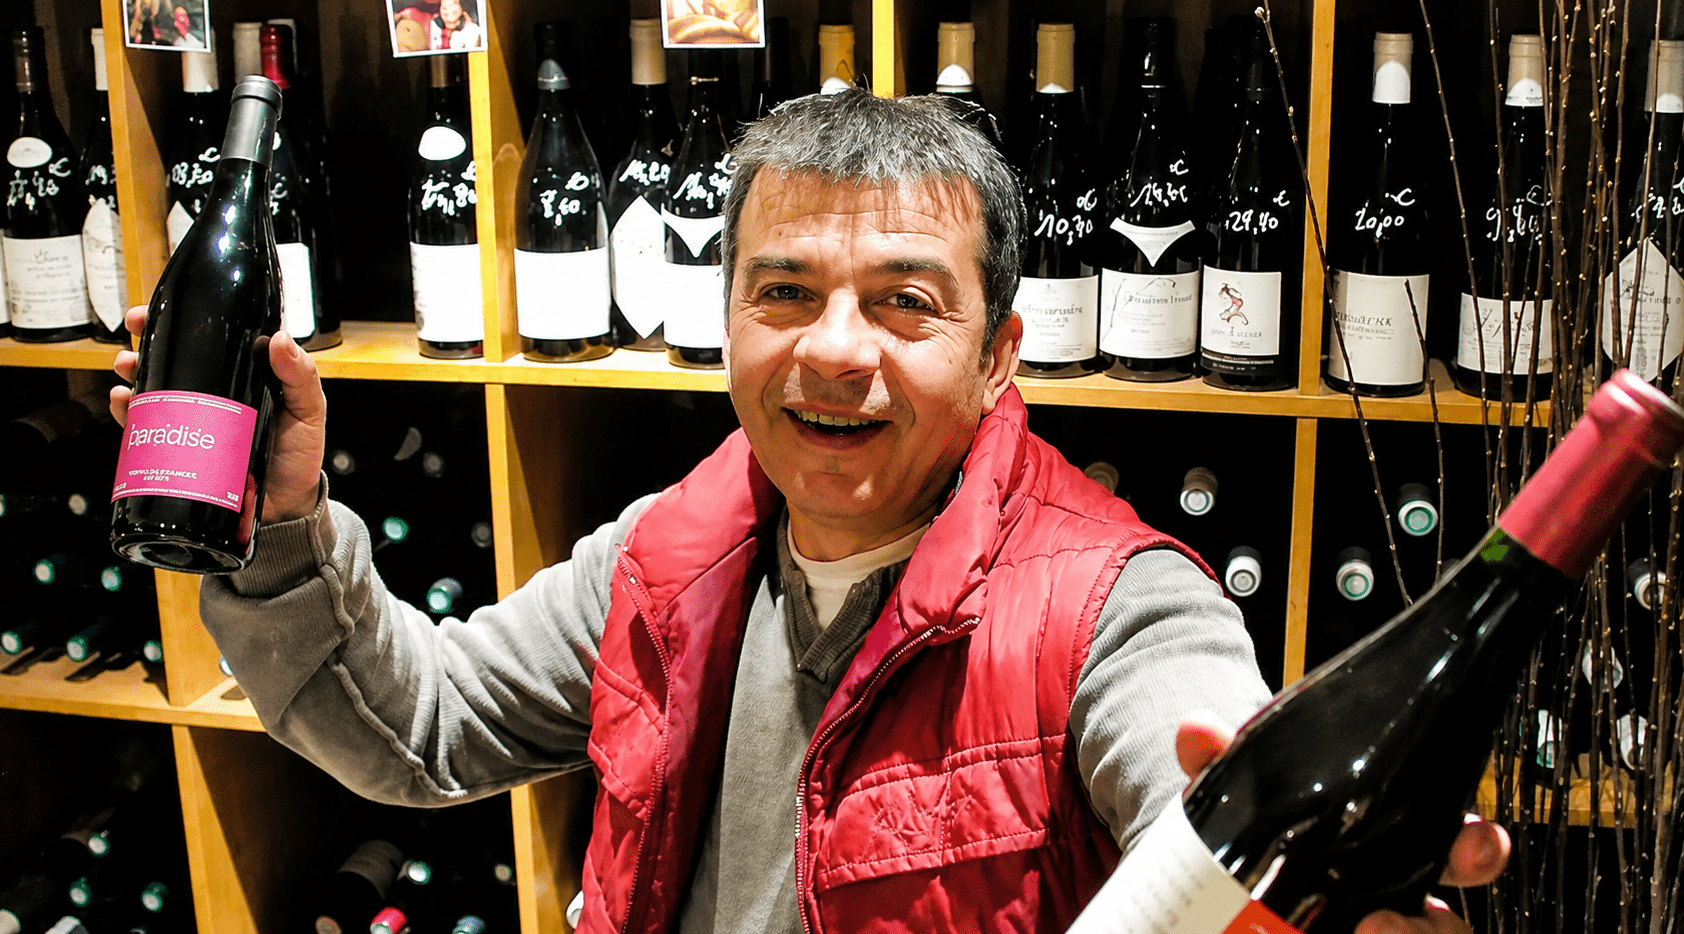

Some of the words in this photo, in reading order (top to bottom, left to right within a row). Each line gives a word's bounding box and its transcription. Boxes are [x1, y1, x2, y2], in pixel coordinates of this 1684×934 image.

[1272, 189, 1291, 207] €
[1354, 207, 1405, 239] 20,00
[126, 423, 216, 450] paradise
